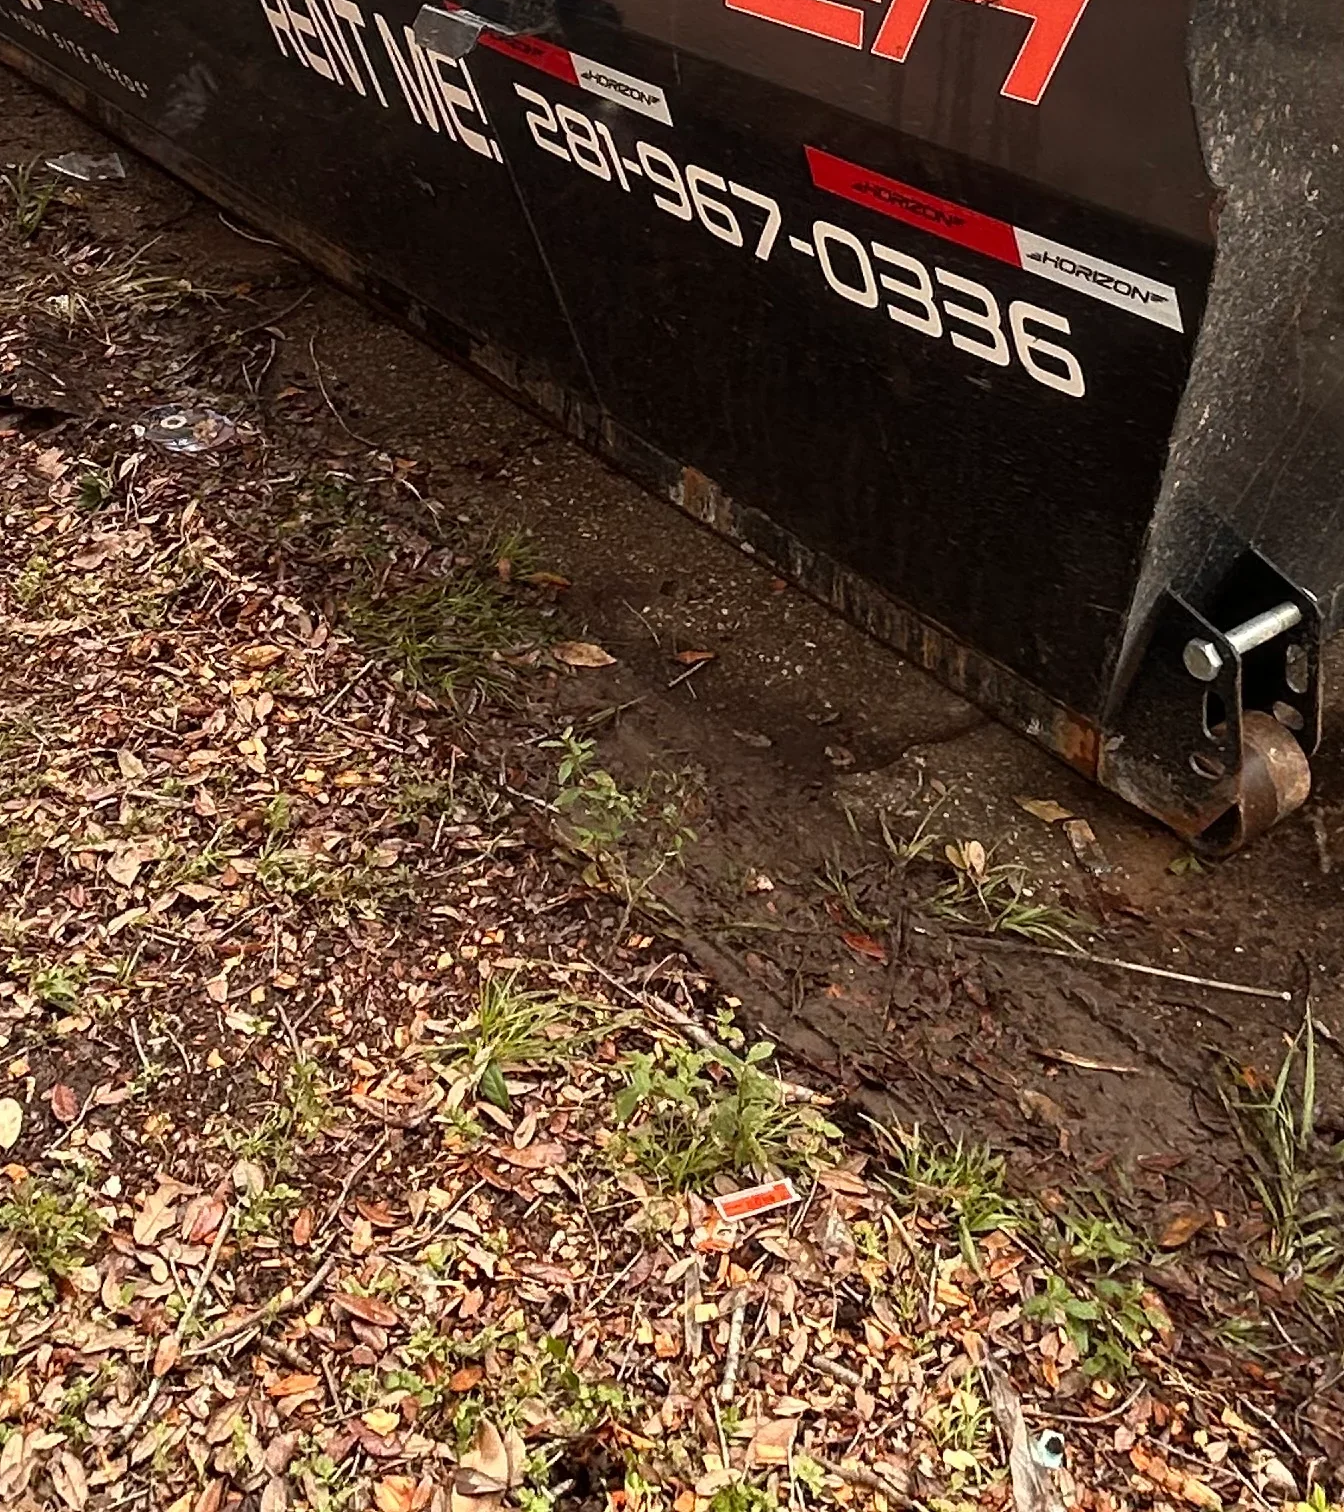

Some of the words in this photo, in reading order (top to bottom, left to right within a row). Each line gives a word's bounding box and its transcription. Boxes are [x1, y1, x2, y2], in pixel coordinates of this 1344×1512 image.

[373, 12, 505, 165] ME!
[586, 69, 653, 107] HORIZON
[513, 82, 1086, 398] 281-967-0336
[1042, 249, 1151, 304] HORIZON
